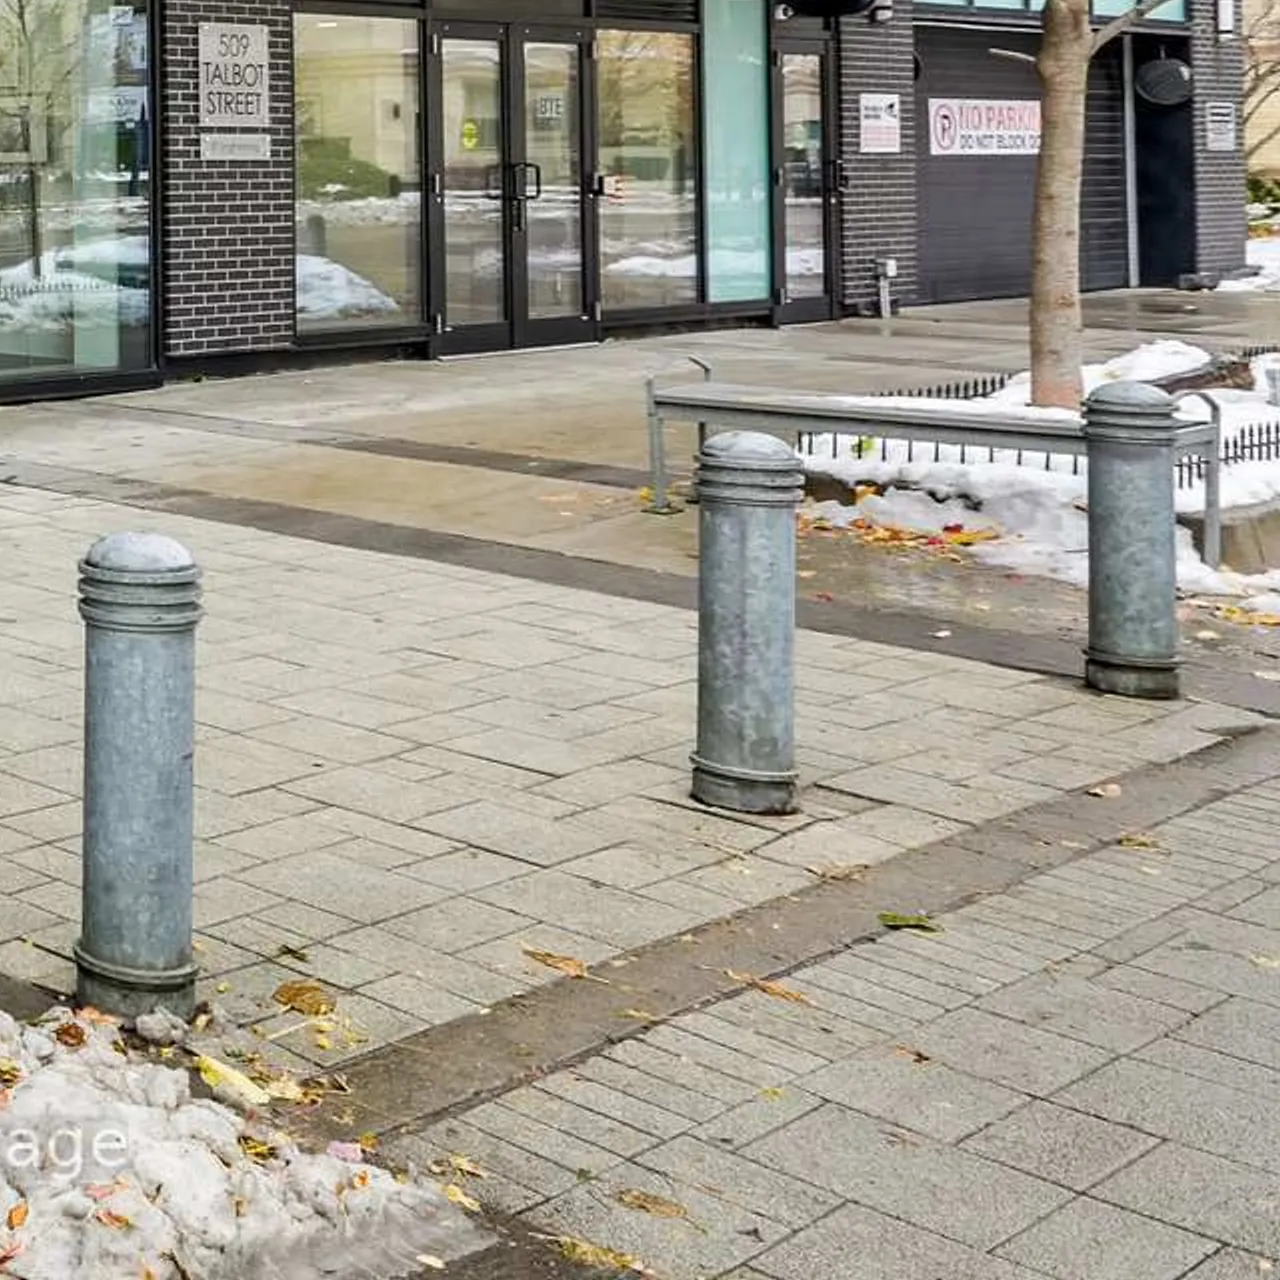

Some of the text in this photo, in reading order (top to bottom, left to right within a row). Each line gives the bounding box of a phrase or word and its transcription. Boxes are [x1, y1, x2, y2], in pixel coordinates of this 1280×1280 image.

[219, 33, 251, 57] 509
[202, 61, 264, 87] TALBOT
[205, 90, 262, 115] STREET
[959, 106, 982, 132] NO
